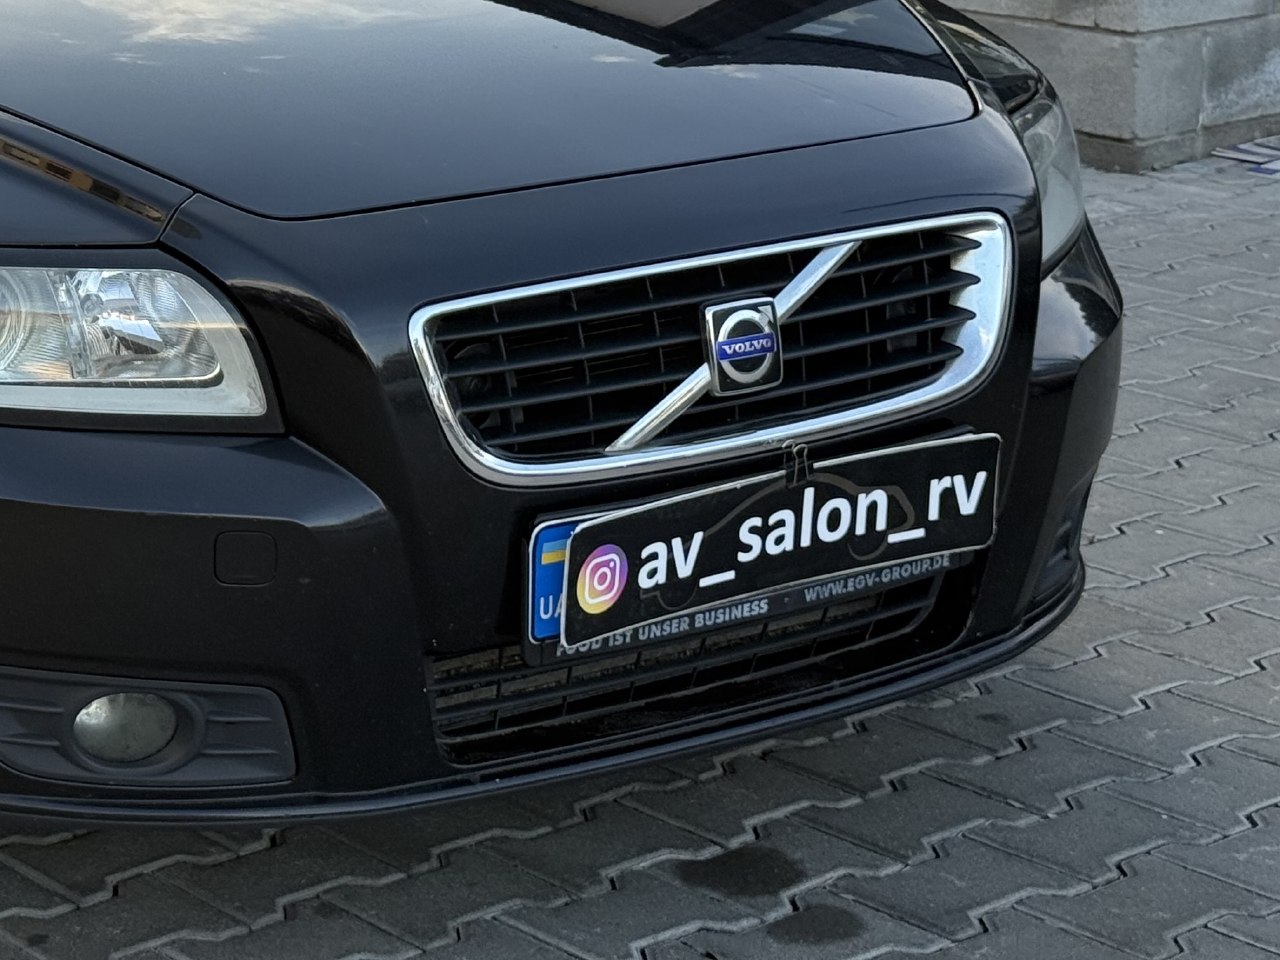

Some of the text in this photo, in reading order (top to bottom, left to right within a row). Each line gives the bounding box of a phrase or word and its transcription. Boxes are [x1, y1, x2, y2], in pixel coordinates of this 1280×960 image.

[722, 338, 772, 355] VOLVO
[637, 470, 988, 589] av_salon_rv
[638, 617, 690, 640] UNSER
[694, 599, 769, 629] BUSINESS
